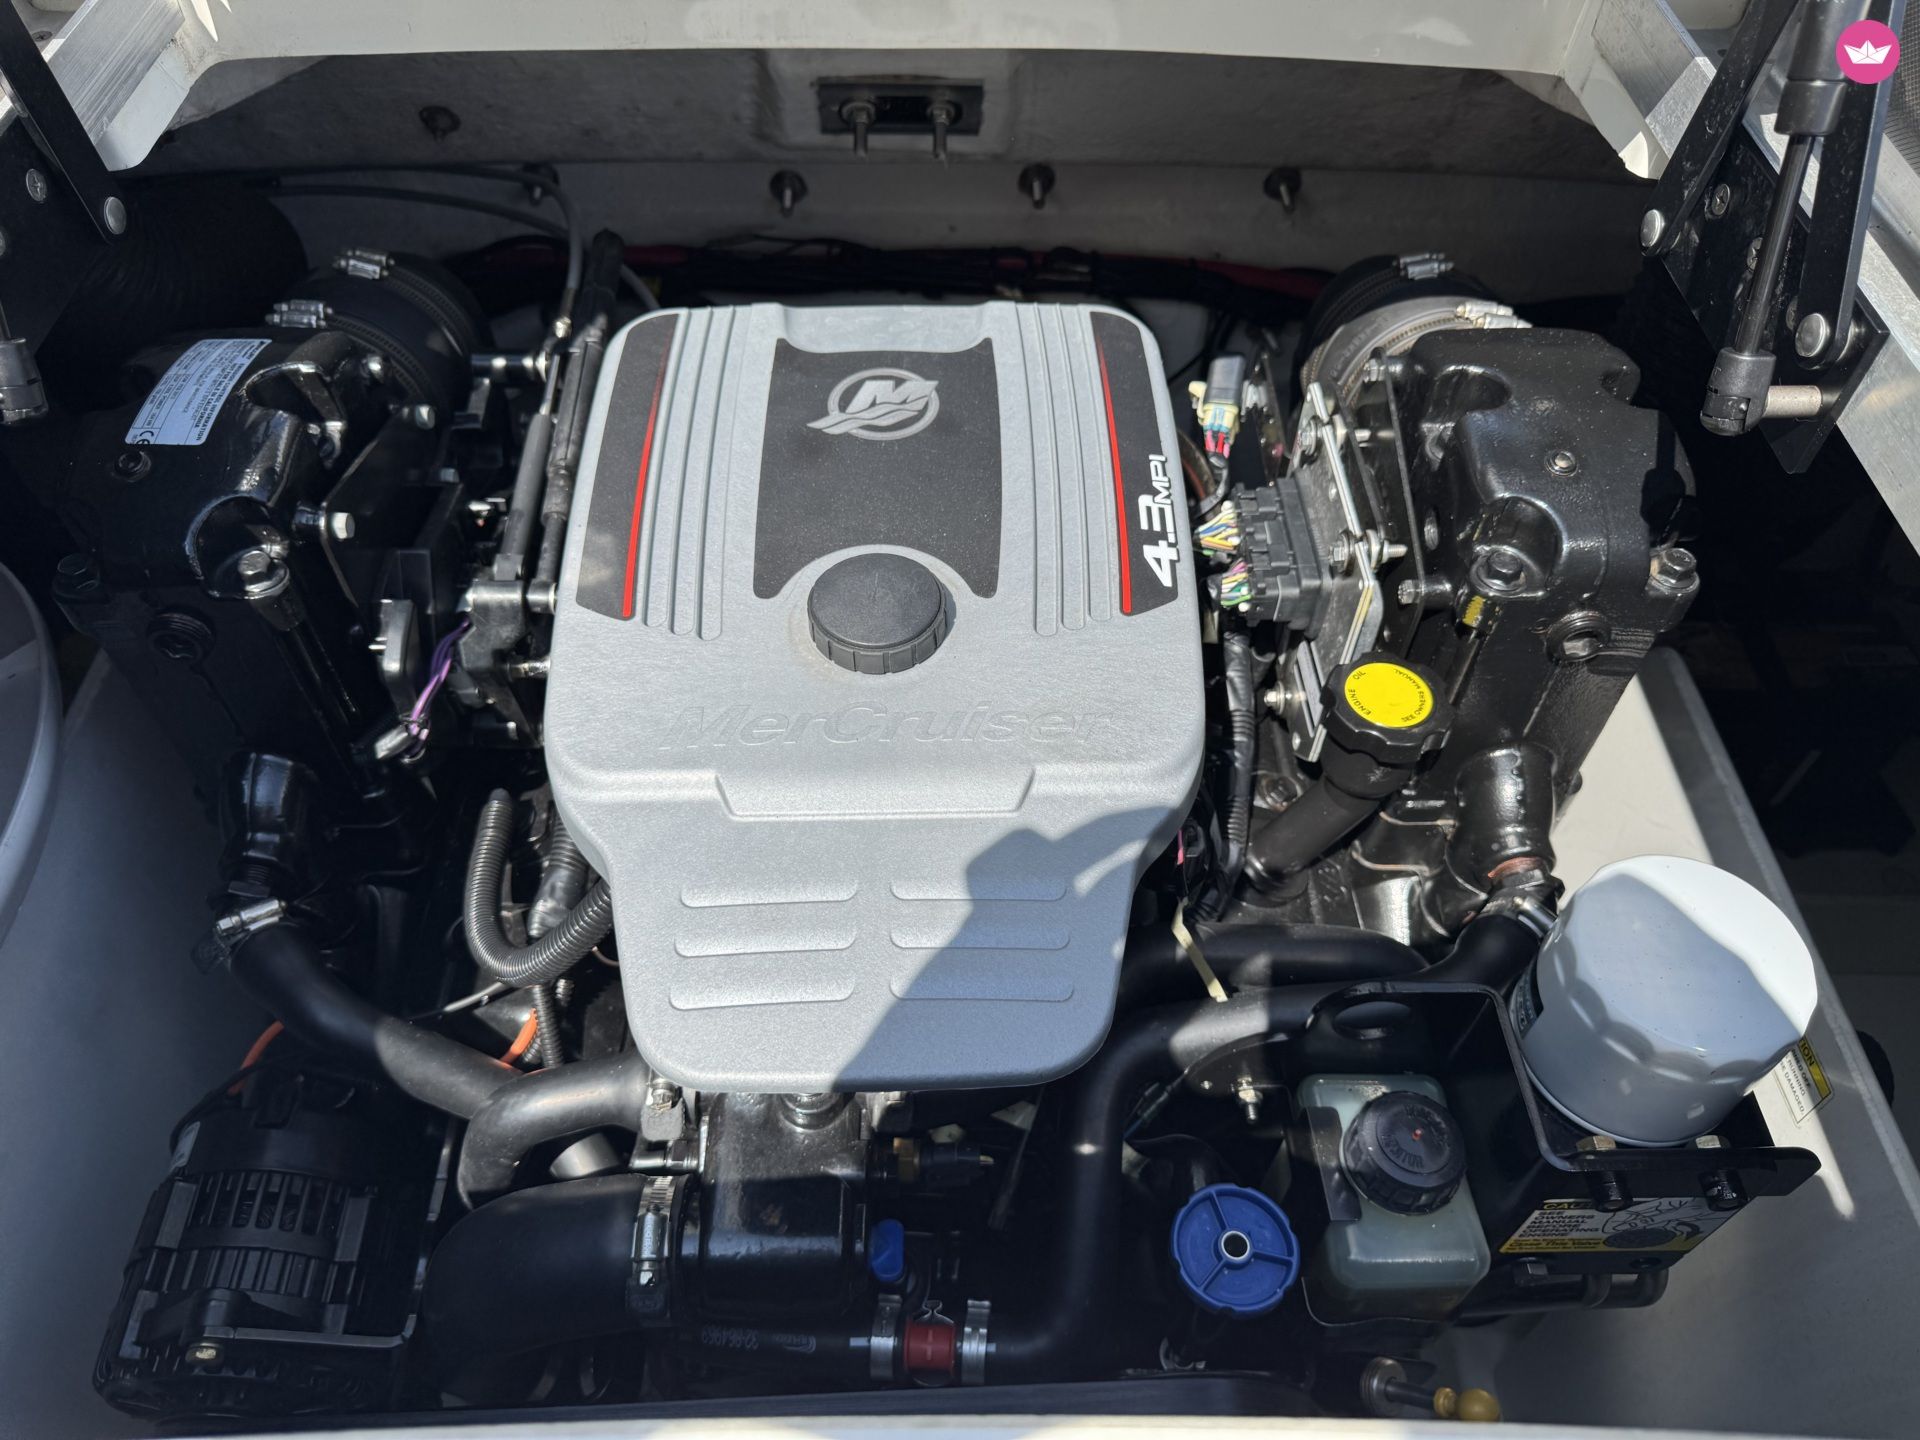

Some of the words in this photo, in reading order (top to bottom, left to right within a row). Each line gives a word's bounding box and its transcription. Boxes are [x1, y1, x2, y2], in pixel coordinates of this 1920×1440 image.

[193, 398, 214, 428] CALIFORNIA
[195, 404, 217, 440] INFORMATION
[1353, 671, 1366, 680] OIL
[1393, 668, 1421, 690] MANUAL
[1348, 689, 1372, 716] ENGINE
[656, 702, 1112, 751] MerCruiser
